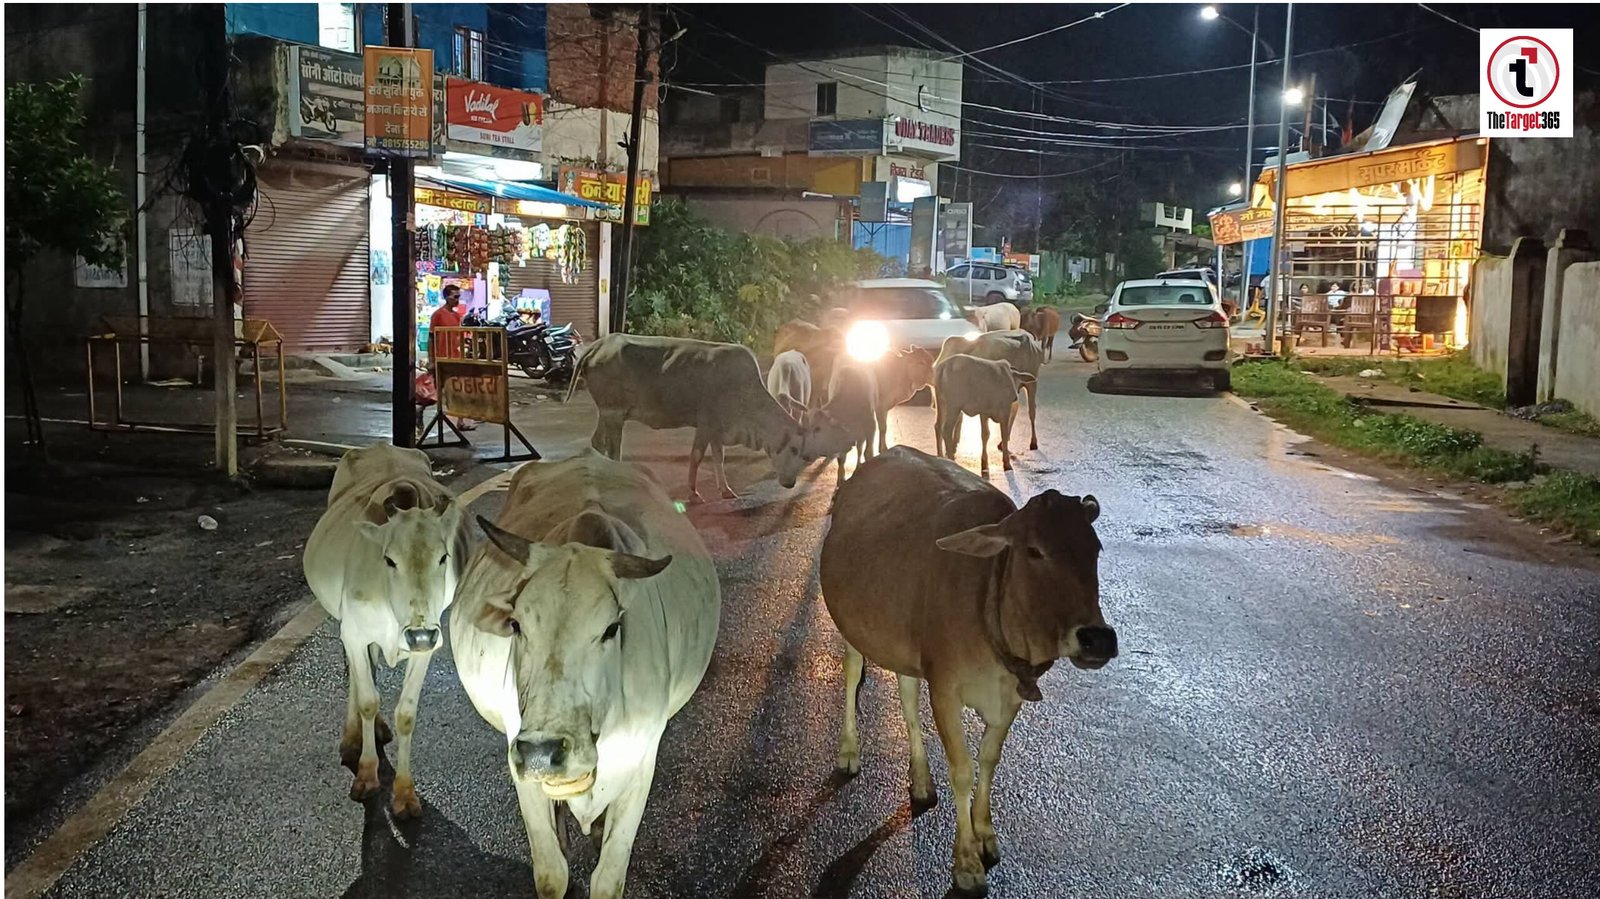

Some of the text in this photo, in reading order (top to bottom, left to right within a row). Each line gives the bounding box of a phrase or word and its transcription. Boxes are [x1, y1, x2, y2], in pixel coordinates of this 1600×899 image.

[301, 60, 321, 79] सोनी
[322, 65, 342, 84] ऑटो
[464, 89, 500, 120] Vadilal
